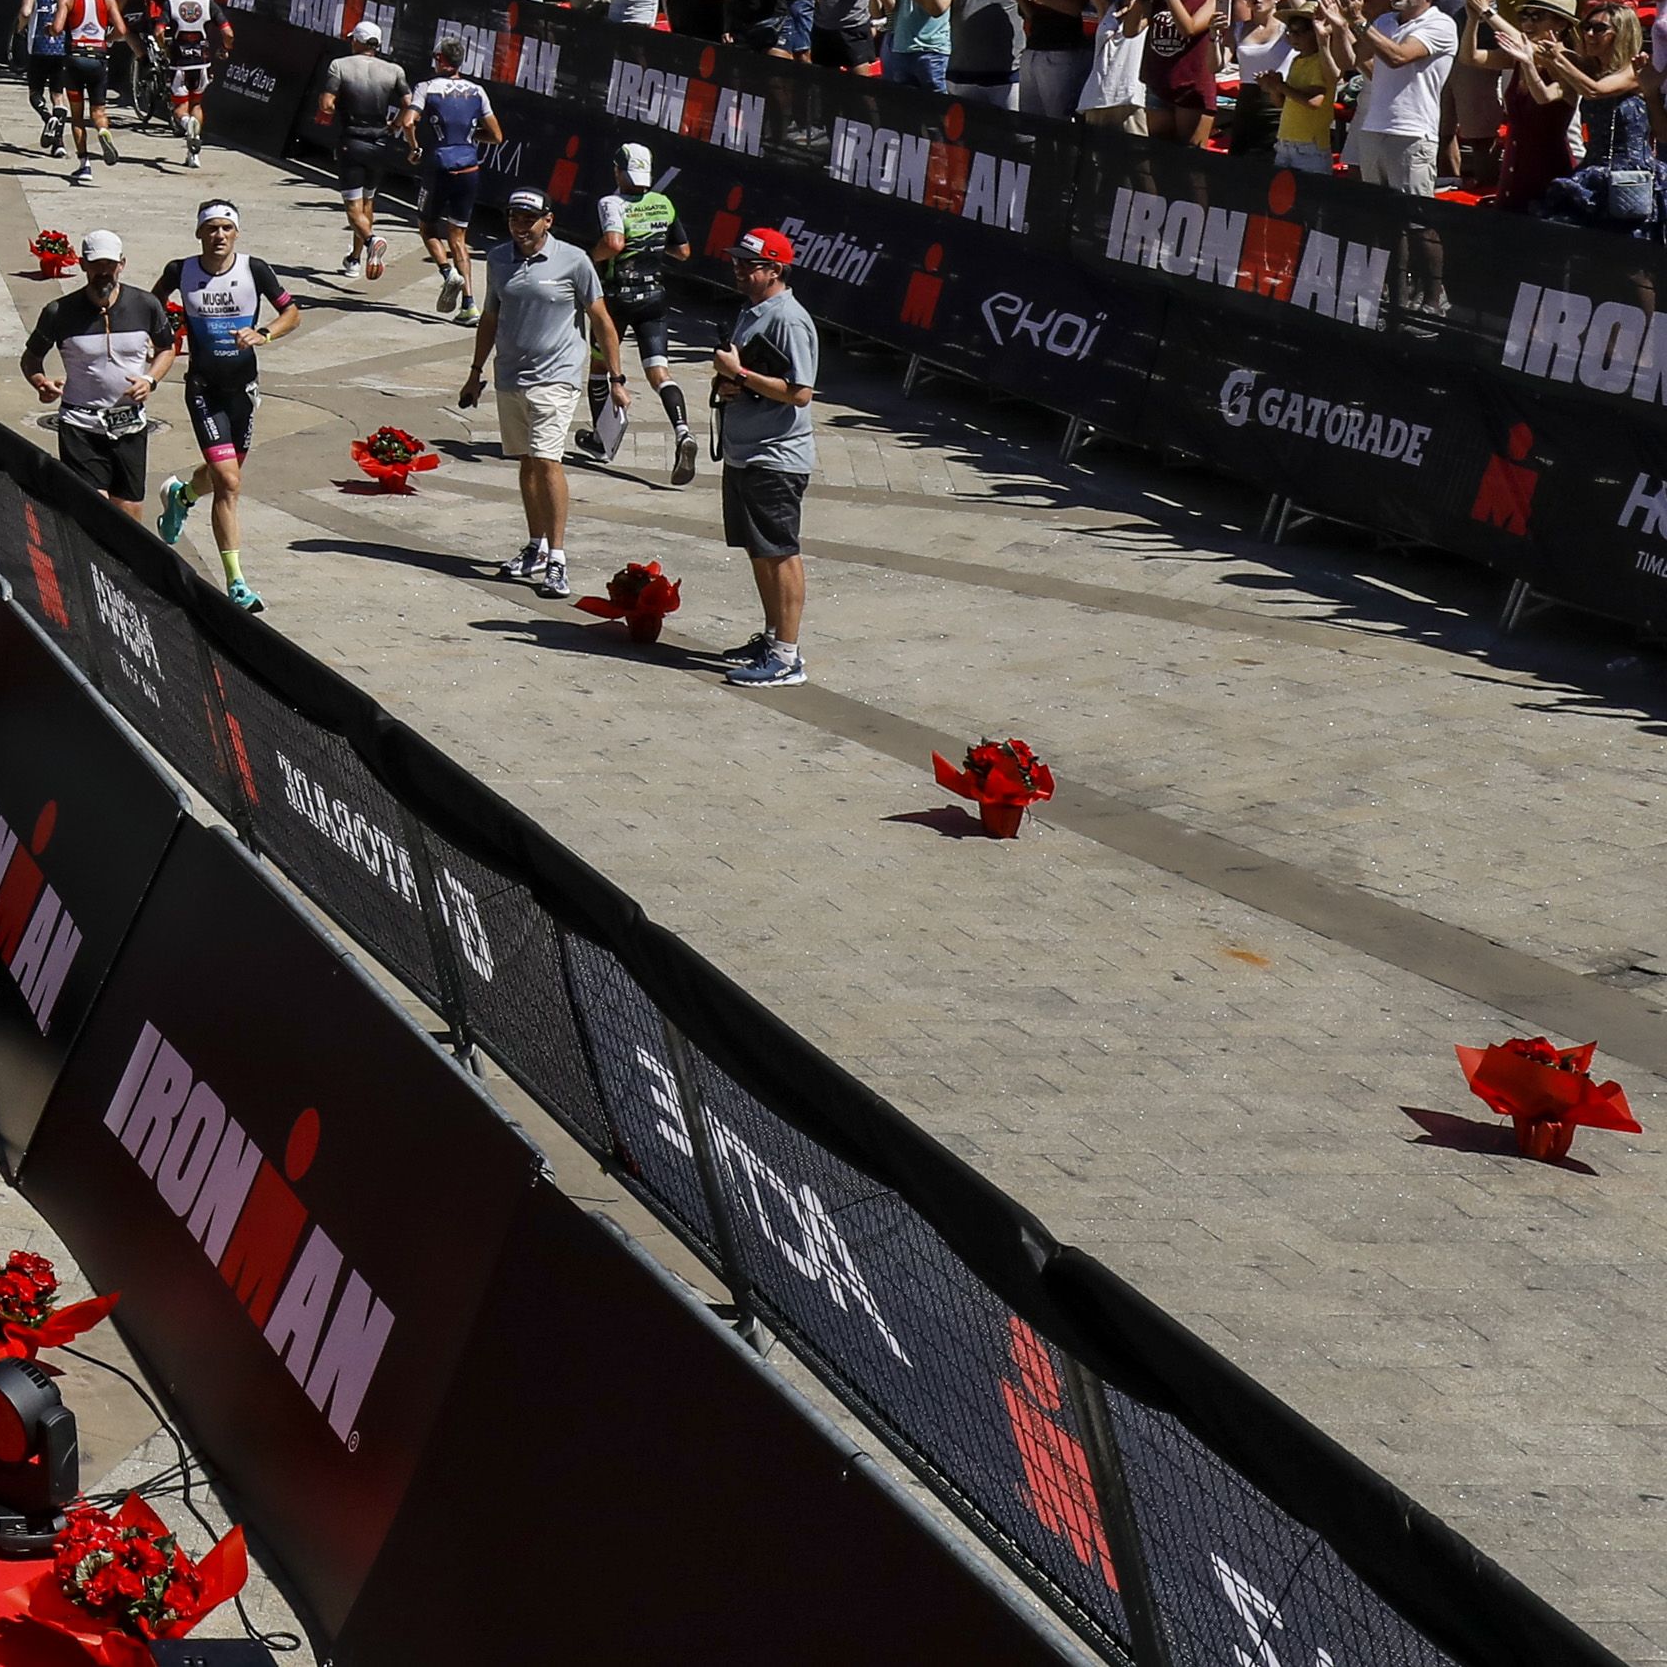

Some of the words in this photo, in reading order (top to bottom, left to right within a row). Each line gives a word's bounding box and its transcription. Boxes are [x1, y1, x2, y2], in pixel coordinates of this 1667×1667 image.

[605, 45, 765, 158] IRONMAN
[829, 102, 1032, 234] IRONMAN
[202, 292, 235, 306] MUGICA
[1105, 167, 1391, 330] IRONMAN
[1257, 387, 1433, 467] GATORADE
[103, 1019, 395, 1444] IRONMAN
